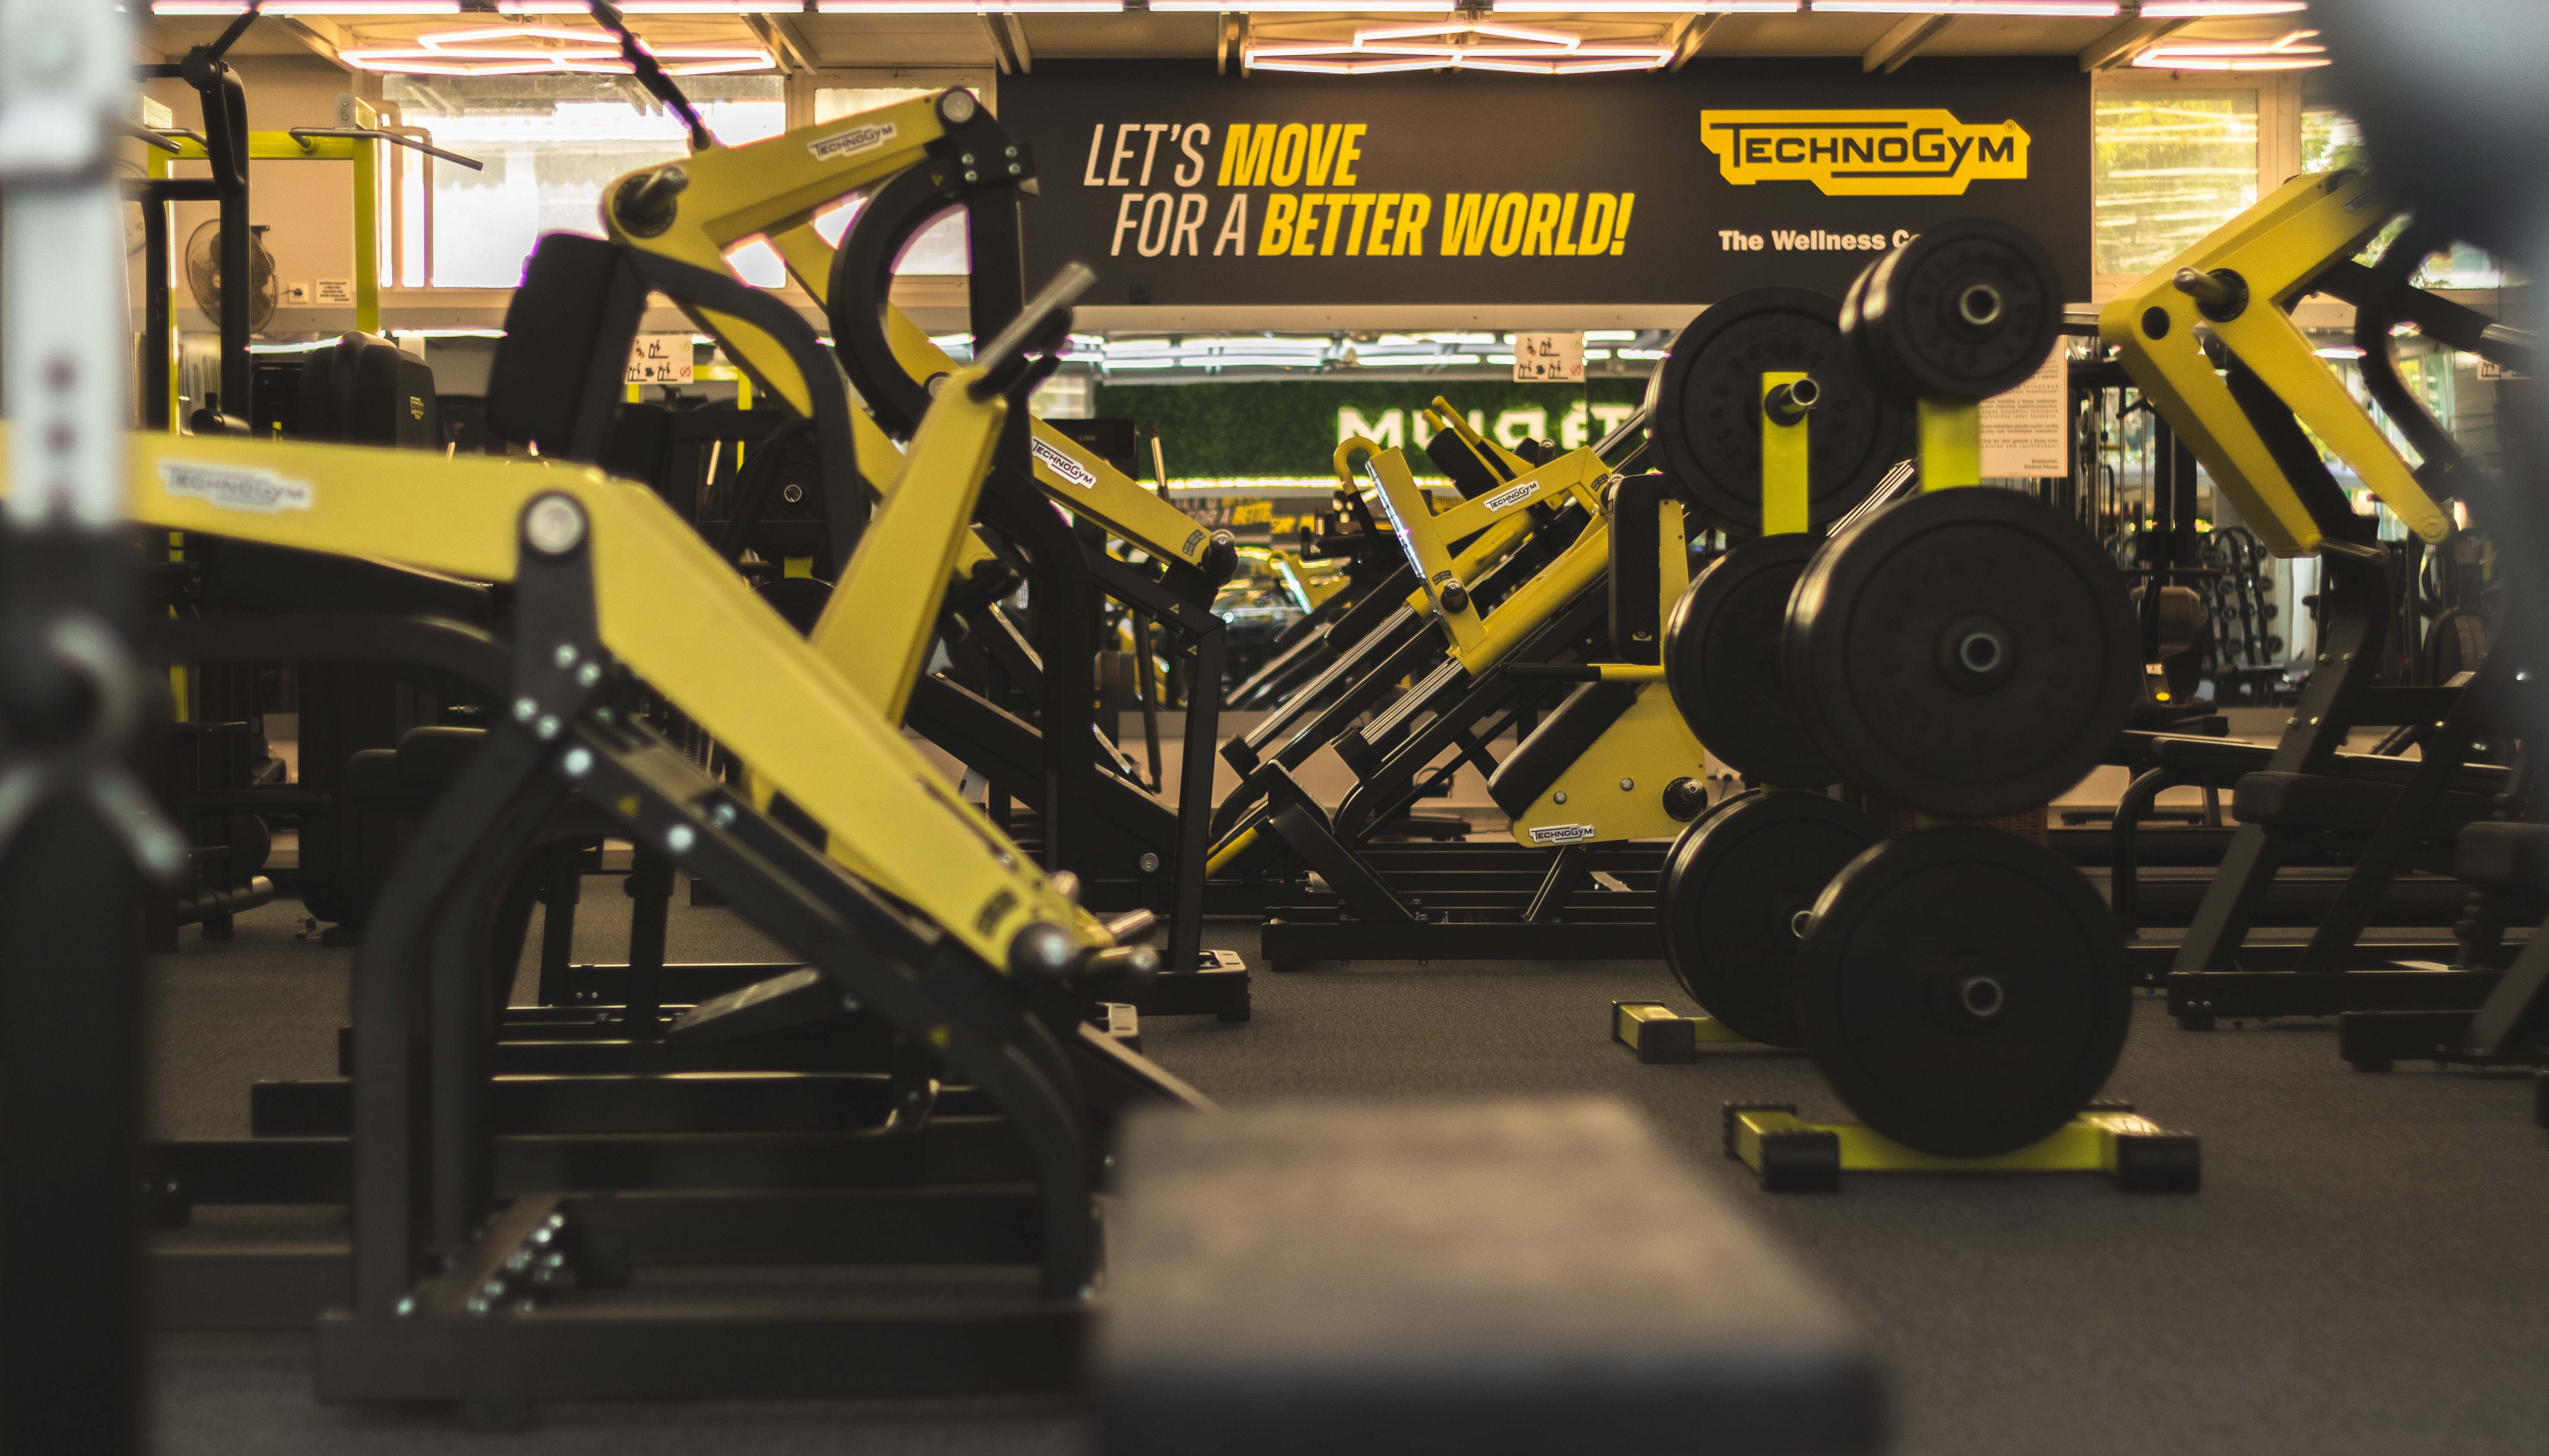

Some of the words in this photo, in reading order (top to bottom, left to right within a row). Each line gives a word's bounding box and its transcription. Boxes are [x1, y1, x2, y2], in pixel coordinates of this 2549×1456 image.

[1084, 123, 1210, 187] LET'S
[1217, 122, 1368, 187] MOVE
[1111, 192, 1208, 257] FOR
[1213, 193, 1248, 256] A
[1258, 192, 1432, 256] BETTER
[1441, 191, 1636, 257] WORLD!
[1719, 230, 1764, 251] The
[1771, 230, 1886, 251] Wellness
